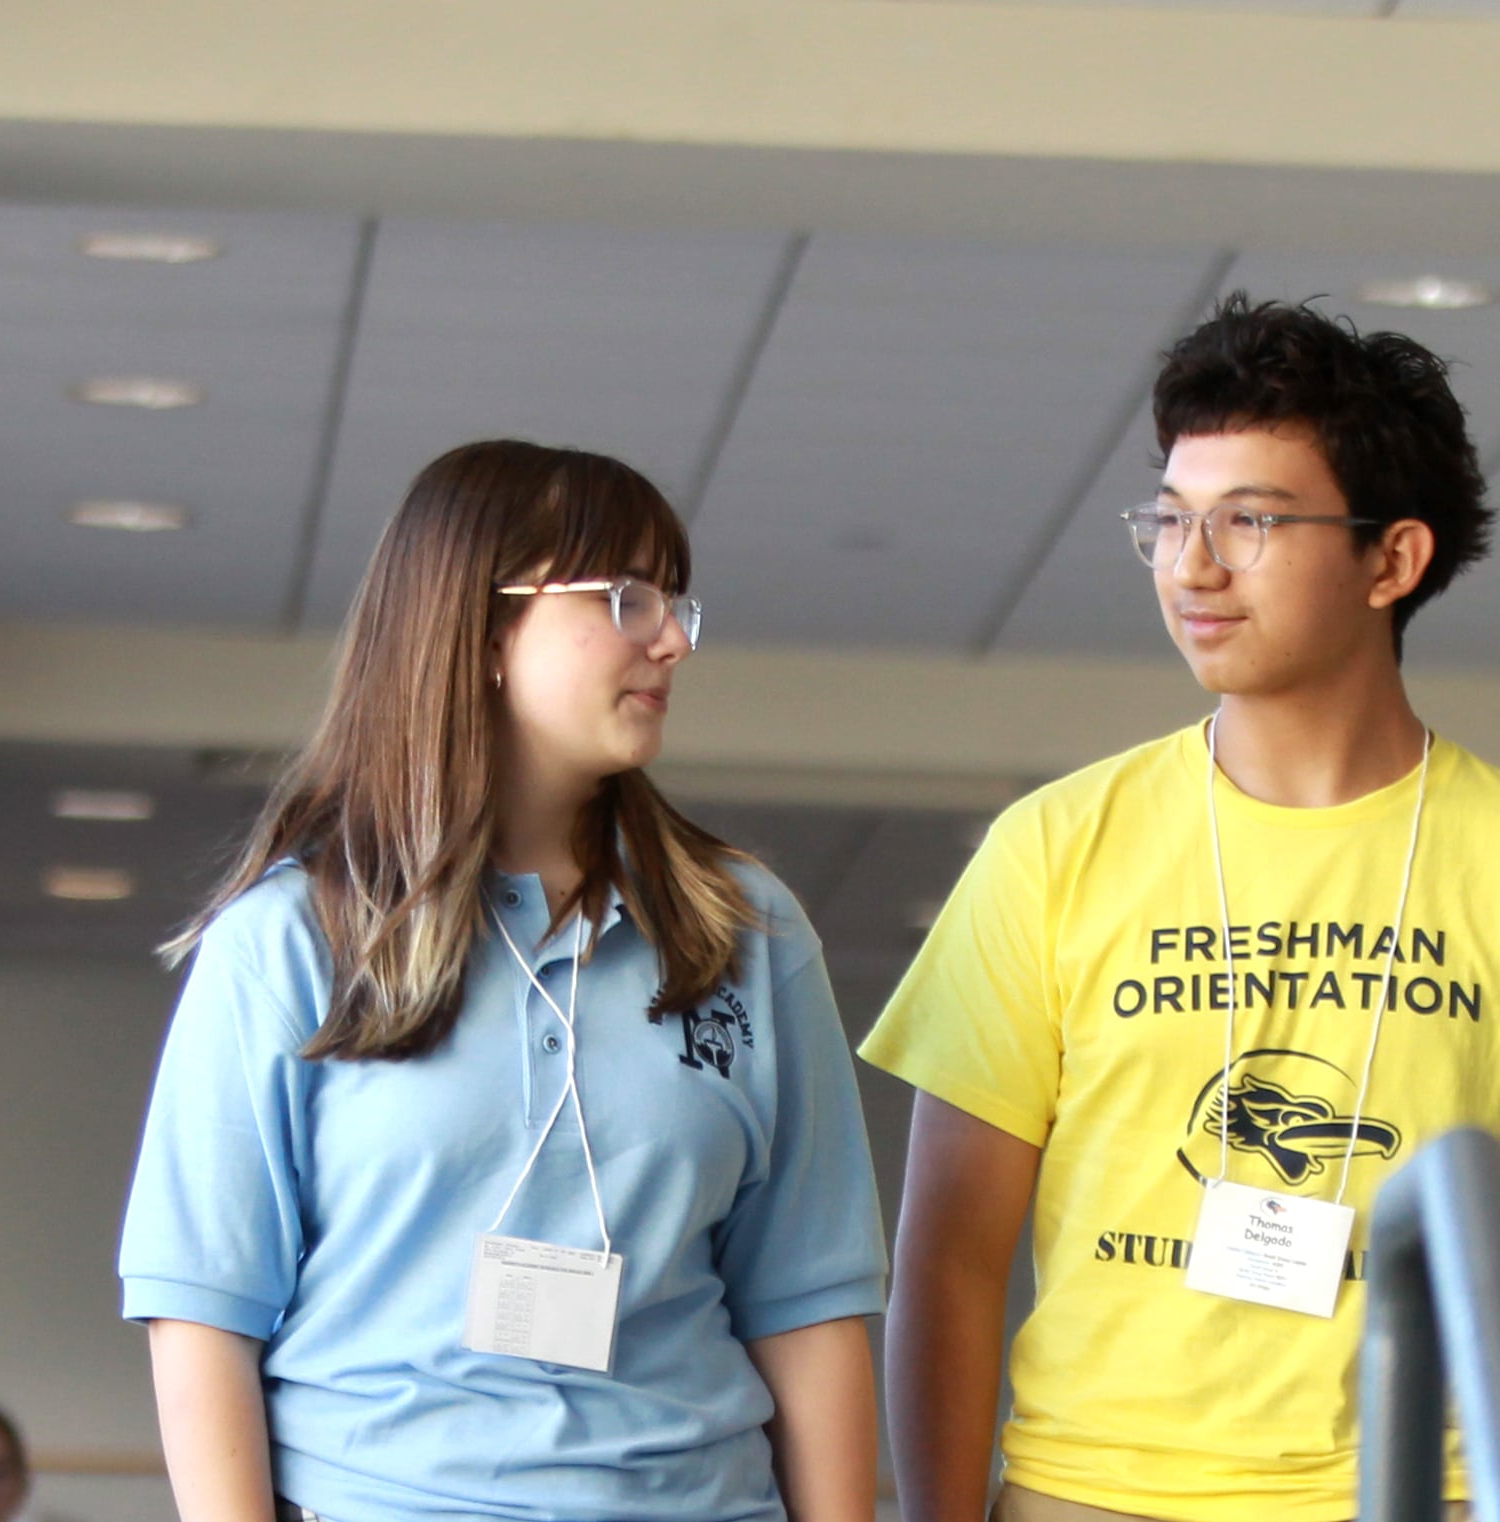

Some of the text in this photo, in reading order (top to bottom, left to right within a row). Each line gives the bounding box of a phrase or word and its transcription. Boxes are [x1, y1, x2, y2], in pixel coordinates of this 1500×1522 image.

[1151, 922, 1445, 966] FRESHMAN
[1113, 970, 1482, 1022] ORIENTATION
[1244, 1228, 1292, 1248] Delgado
[1248, 1214, 1293, 1234] Thomas
